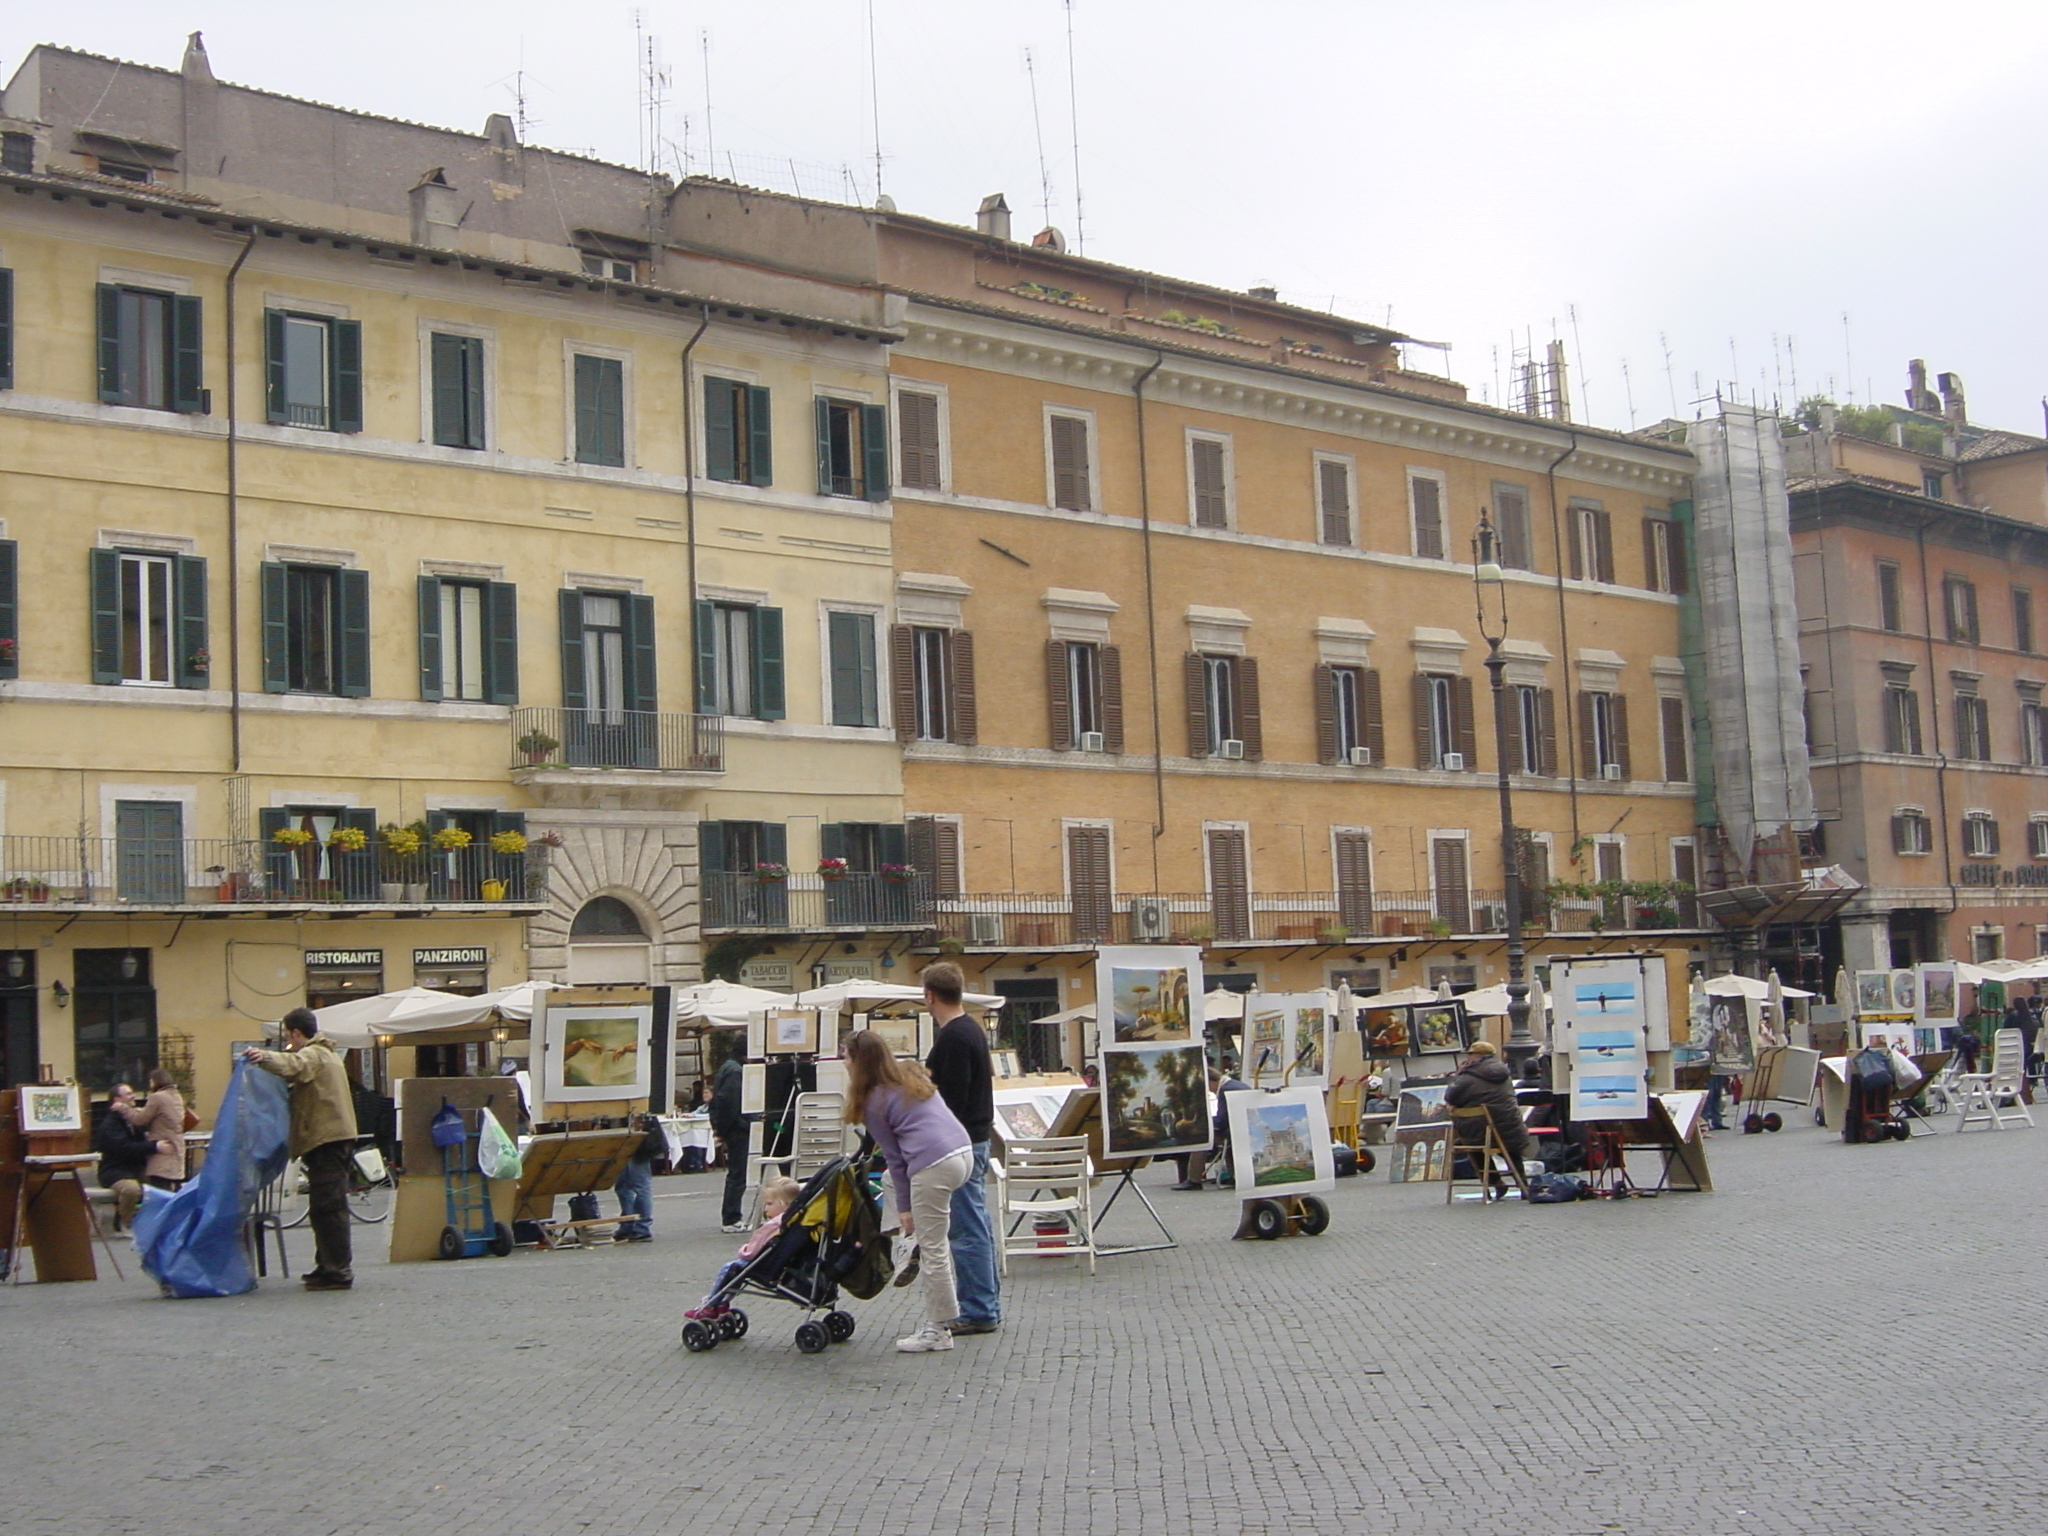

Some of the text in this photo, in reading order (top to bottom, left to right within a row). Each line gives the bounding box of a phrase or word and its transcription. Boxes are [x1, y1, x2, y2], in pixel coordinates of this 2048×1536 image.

[306, 952, 380, 964] RISTORANTE
[415, 950, 483, 962] PANZIRONI
[750, 965, 788, 976] TABACCHI
[828, 965, 870, 976] ARTOLERIA
